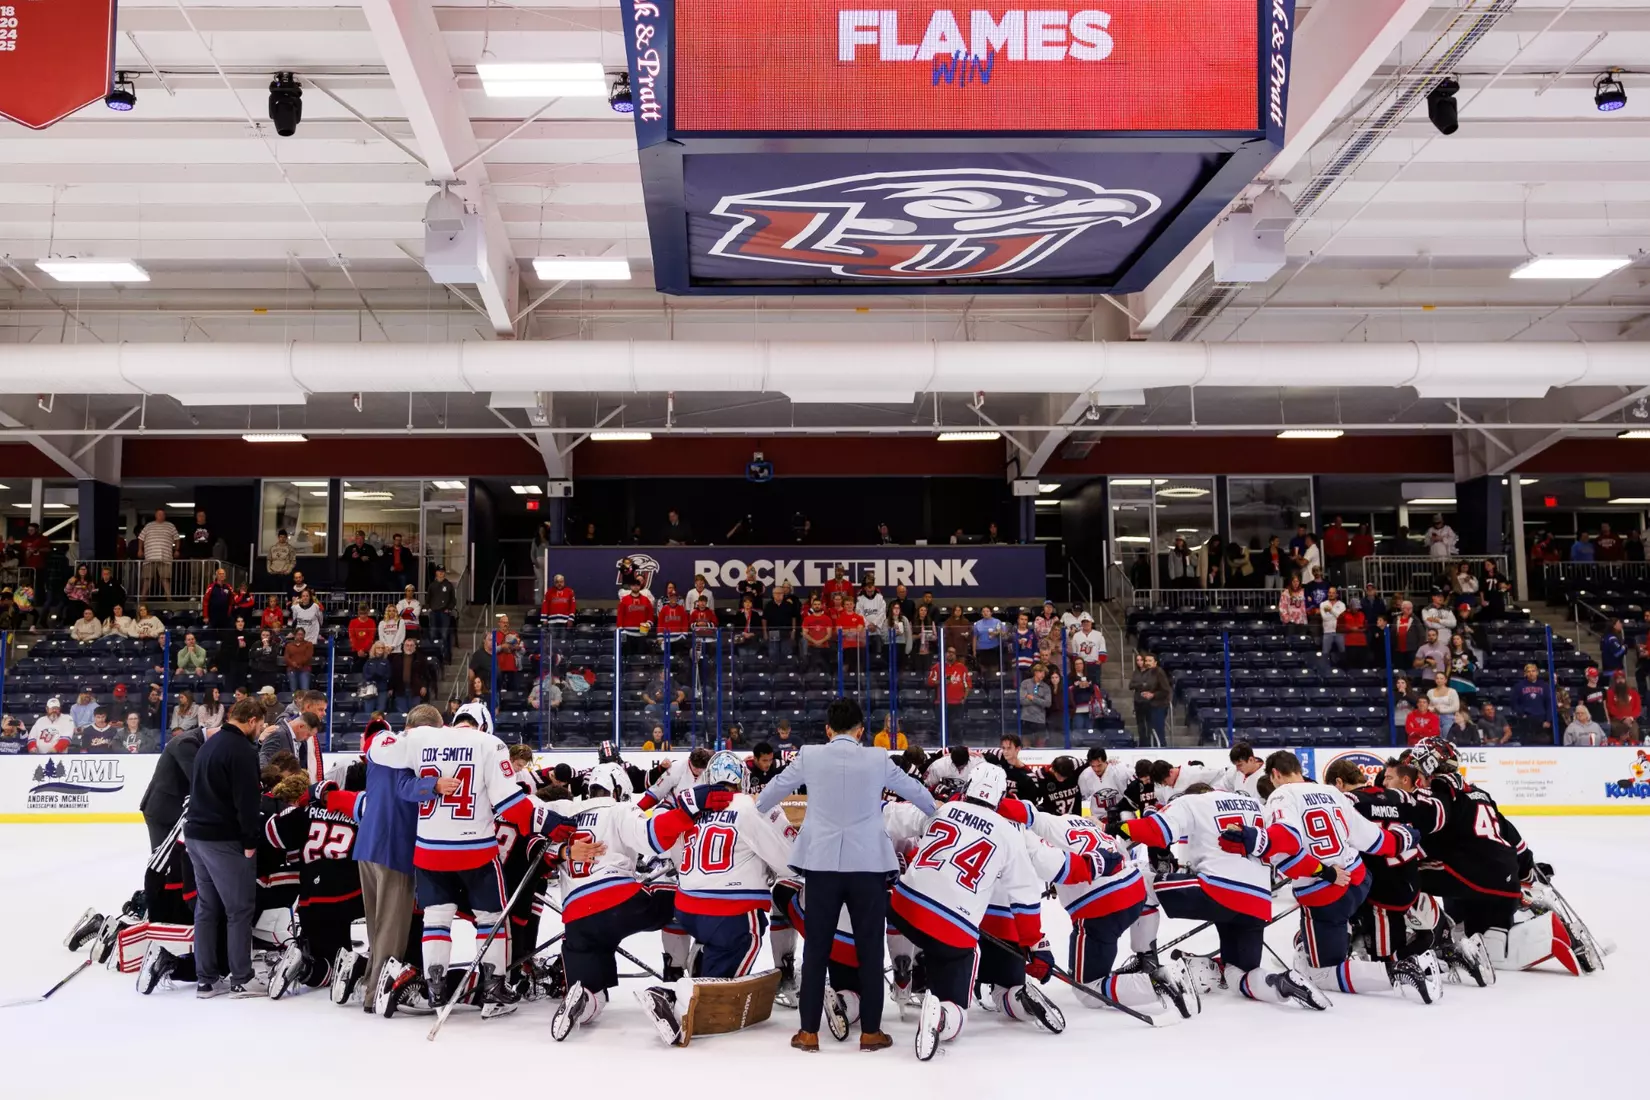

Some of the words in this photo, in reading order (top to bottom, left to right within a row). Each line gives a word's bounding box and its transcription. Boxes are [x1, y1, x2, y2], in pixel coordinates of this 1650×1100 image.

[635, 23, 655, 50] &
[838, 9, 1114, 61] FLAMES
[932, 50, 993, 87] WIN
[637, 49, 661, 121] Pratt
[1270, 52, 1285, 127] Pratt
[694, 560, 801, 587] ROCK
[886, 559, 978, 587] RINK
[422, 747, 473, 762] COX-SMITH
[1460, 752, 1487, 763] AKE
[66, 759, 125, 783] AML
[27, 795, 58, 803] ANDREWS
[61, 795, 89, 803] MCNEILL
[979, 790, 990, 799] 24
[947, 807, 994, 835] DEMARS
[303, 820, 355, 864] 22
[914, 818, 997, 895] 24
